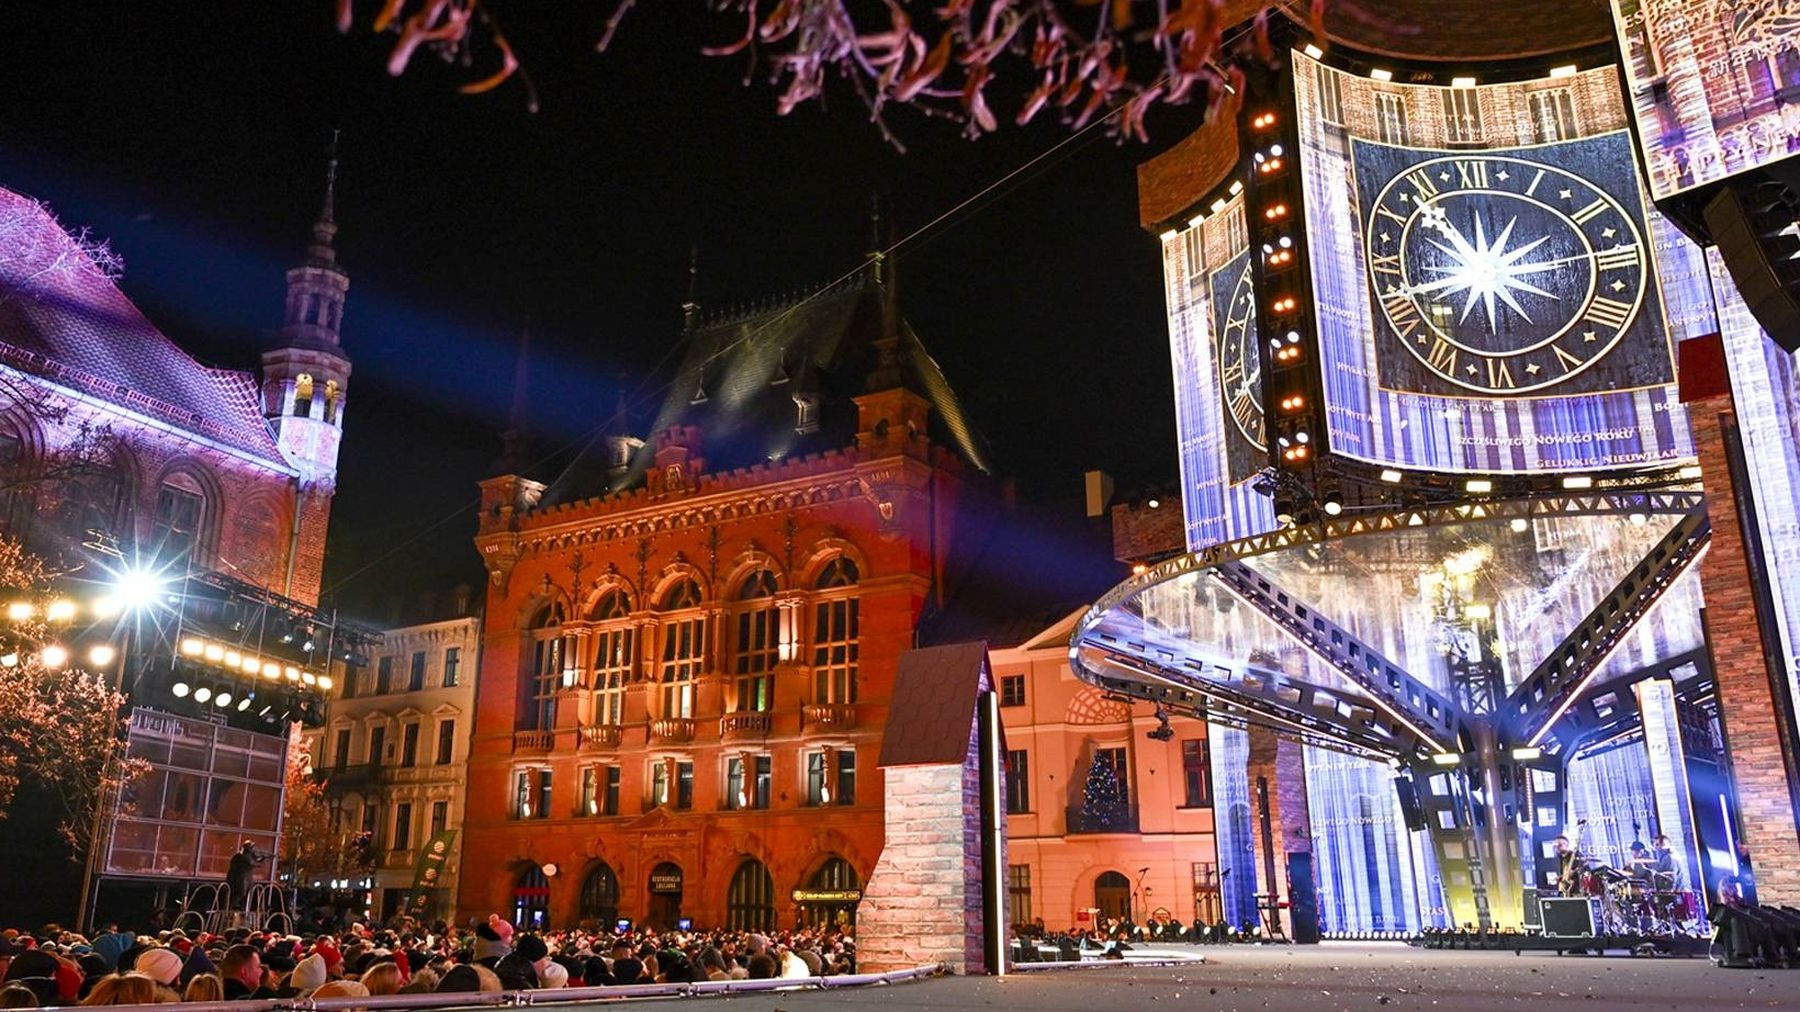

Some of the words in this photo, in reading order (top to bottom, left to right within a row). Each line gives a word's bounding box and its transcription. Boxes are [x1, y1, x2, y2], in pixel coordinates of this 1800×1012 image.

[1455, 160, 1489, 188] XII
[1535, 433, 1592, 446] NOWEGO
[1595, 429, 1633, 442] ROKU
[1534, 456, 1599, 469] GELUKKIG
[1602, 449, 1680, 464] NIEUWJAAR
